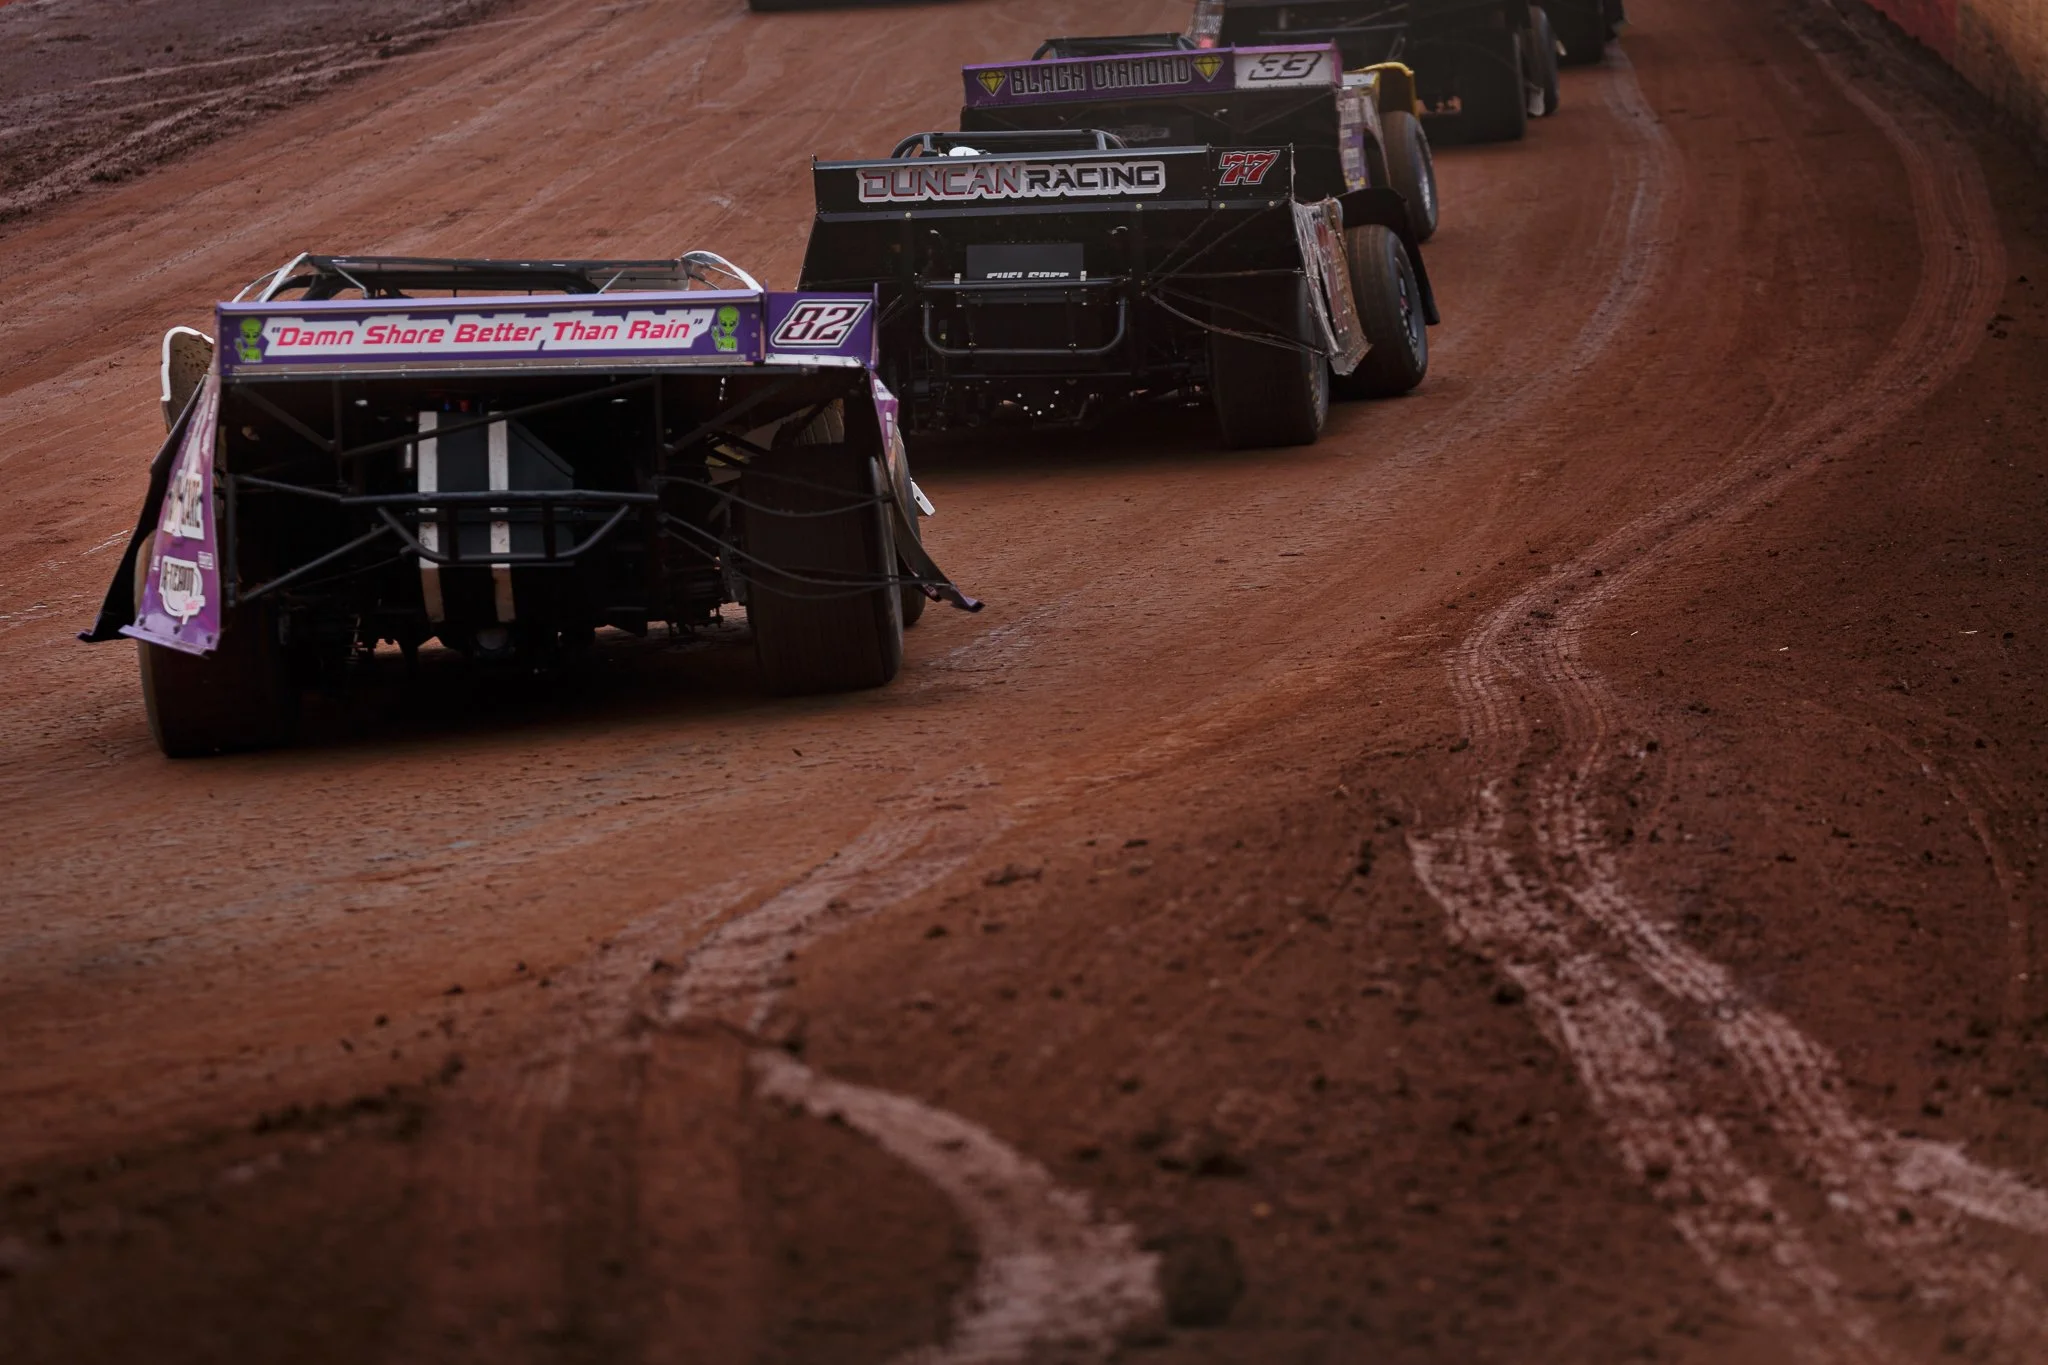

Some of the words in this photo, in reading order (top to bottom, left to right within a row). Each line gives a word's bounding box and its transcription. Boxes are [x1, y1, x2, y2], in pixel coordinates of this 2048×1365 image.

[1009, 62, 1087, 96] BLACK
[1091, 53, 1192, 91] DIAMOND
[861, 164, 1022, 198] DUNCAN
[1024, 165, 1161, 192] RACING
[1219, 150, 1280, 186] 77
[363, 323, 445, 345] Shore
[553, 320, 617, 341] Than
[775, 307, 860, 340] 82
